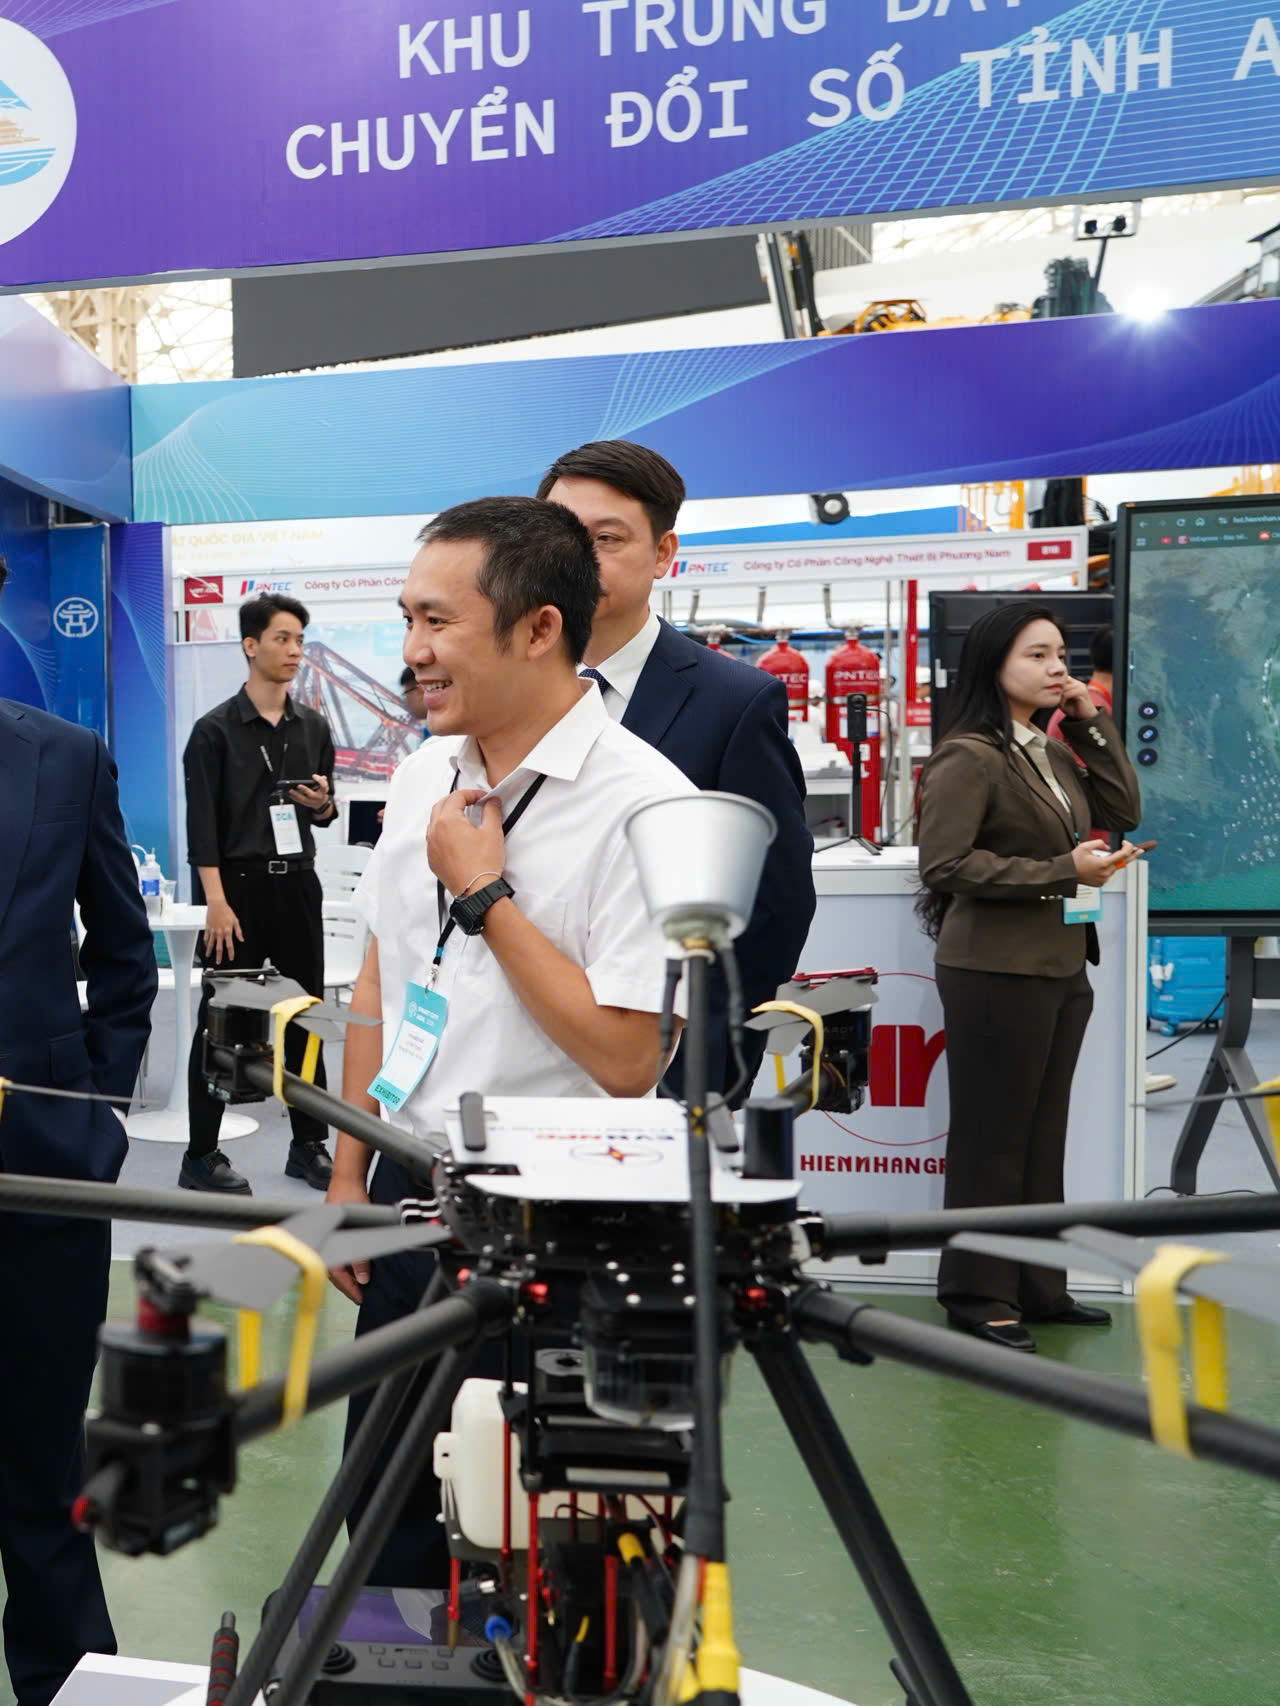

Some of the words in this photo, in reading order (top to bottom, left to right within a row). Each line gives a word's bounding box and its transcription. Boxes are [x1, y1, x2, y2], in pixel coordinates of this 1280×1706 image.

[397, 9, 531, 80] KHU
[285, 85, 556, 181] CHUYỂN
[604, 65, 749, 149] ĐỔI
[806, 41, 906, 128] SỐ
[960, 25, 1173, 108] TỈNH
[304, 580, 331, 592] Công
[331, 580, 341, 591] ty
[687, 561, 730, 575] PNTEC
